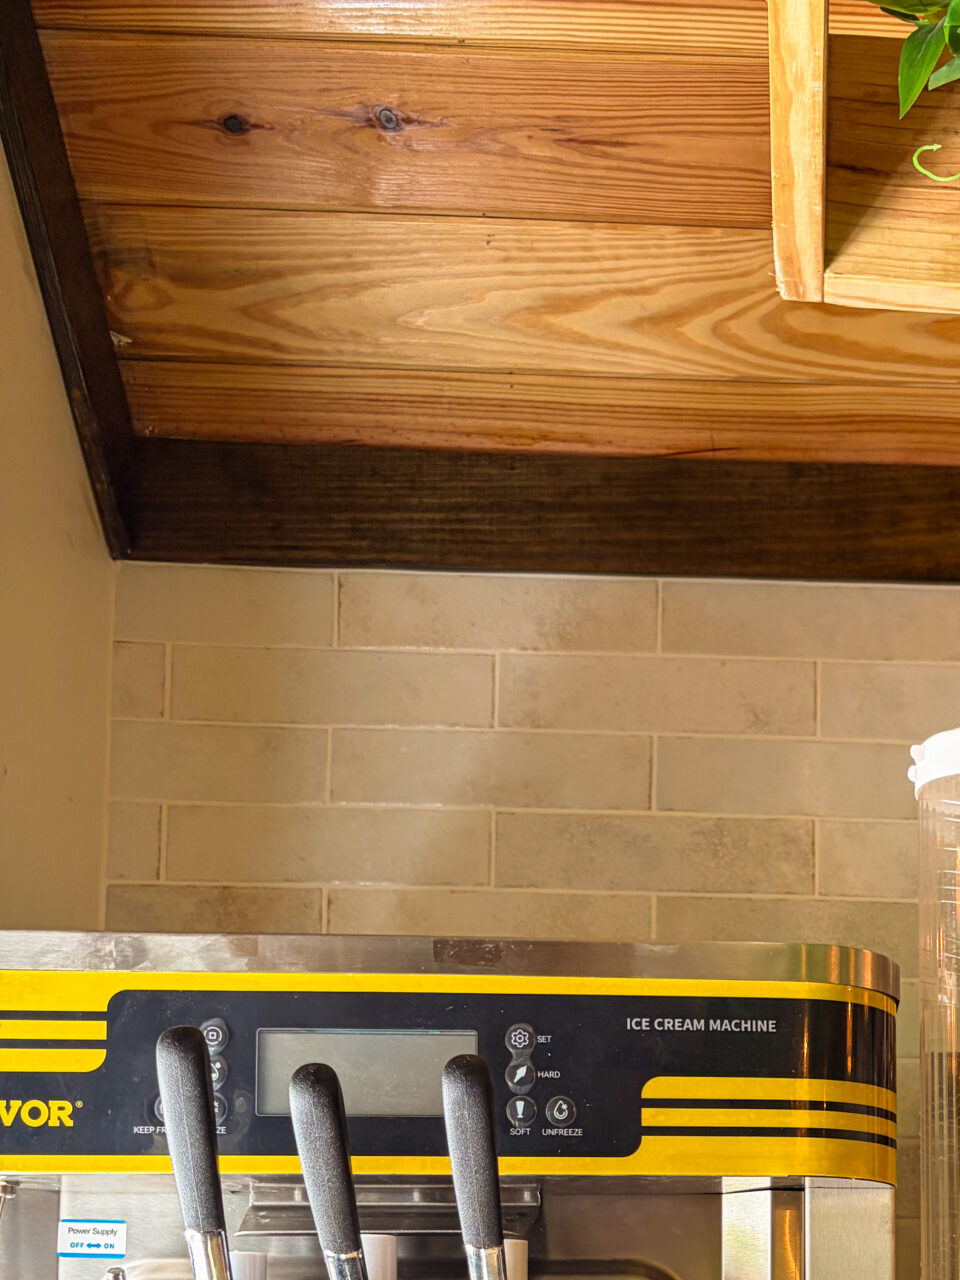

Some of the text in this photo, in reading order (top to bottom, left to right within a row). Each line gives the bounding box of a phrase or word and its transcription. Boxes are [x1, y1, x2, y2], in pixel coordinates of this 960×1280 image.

[626, 1018, 777, 1032] ICE CREAM MACHINE
[537, 1071, 560, 1079] HARD
[133, 1126, 155, 1134] KEEP
[510, 1128, 531, 1136] SOFT
[542, 1128, 584, 1136] UNFREEZE
[68, 1227, 118, 1237] Power Supply
